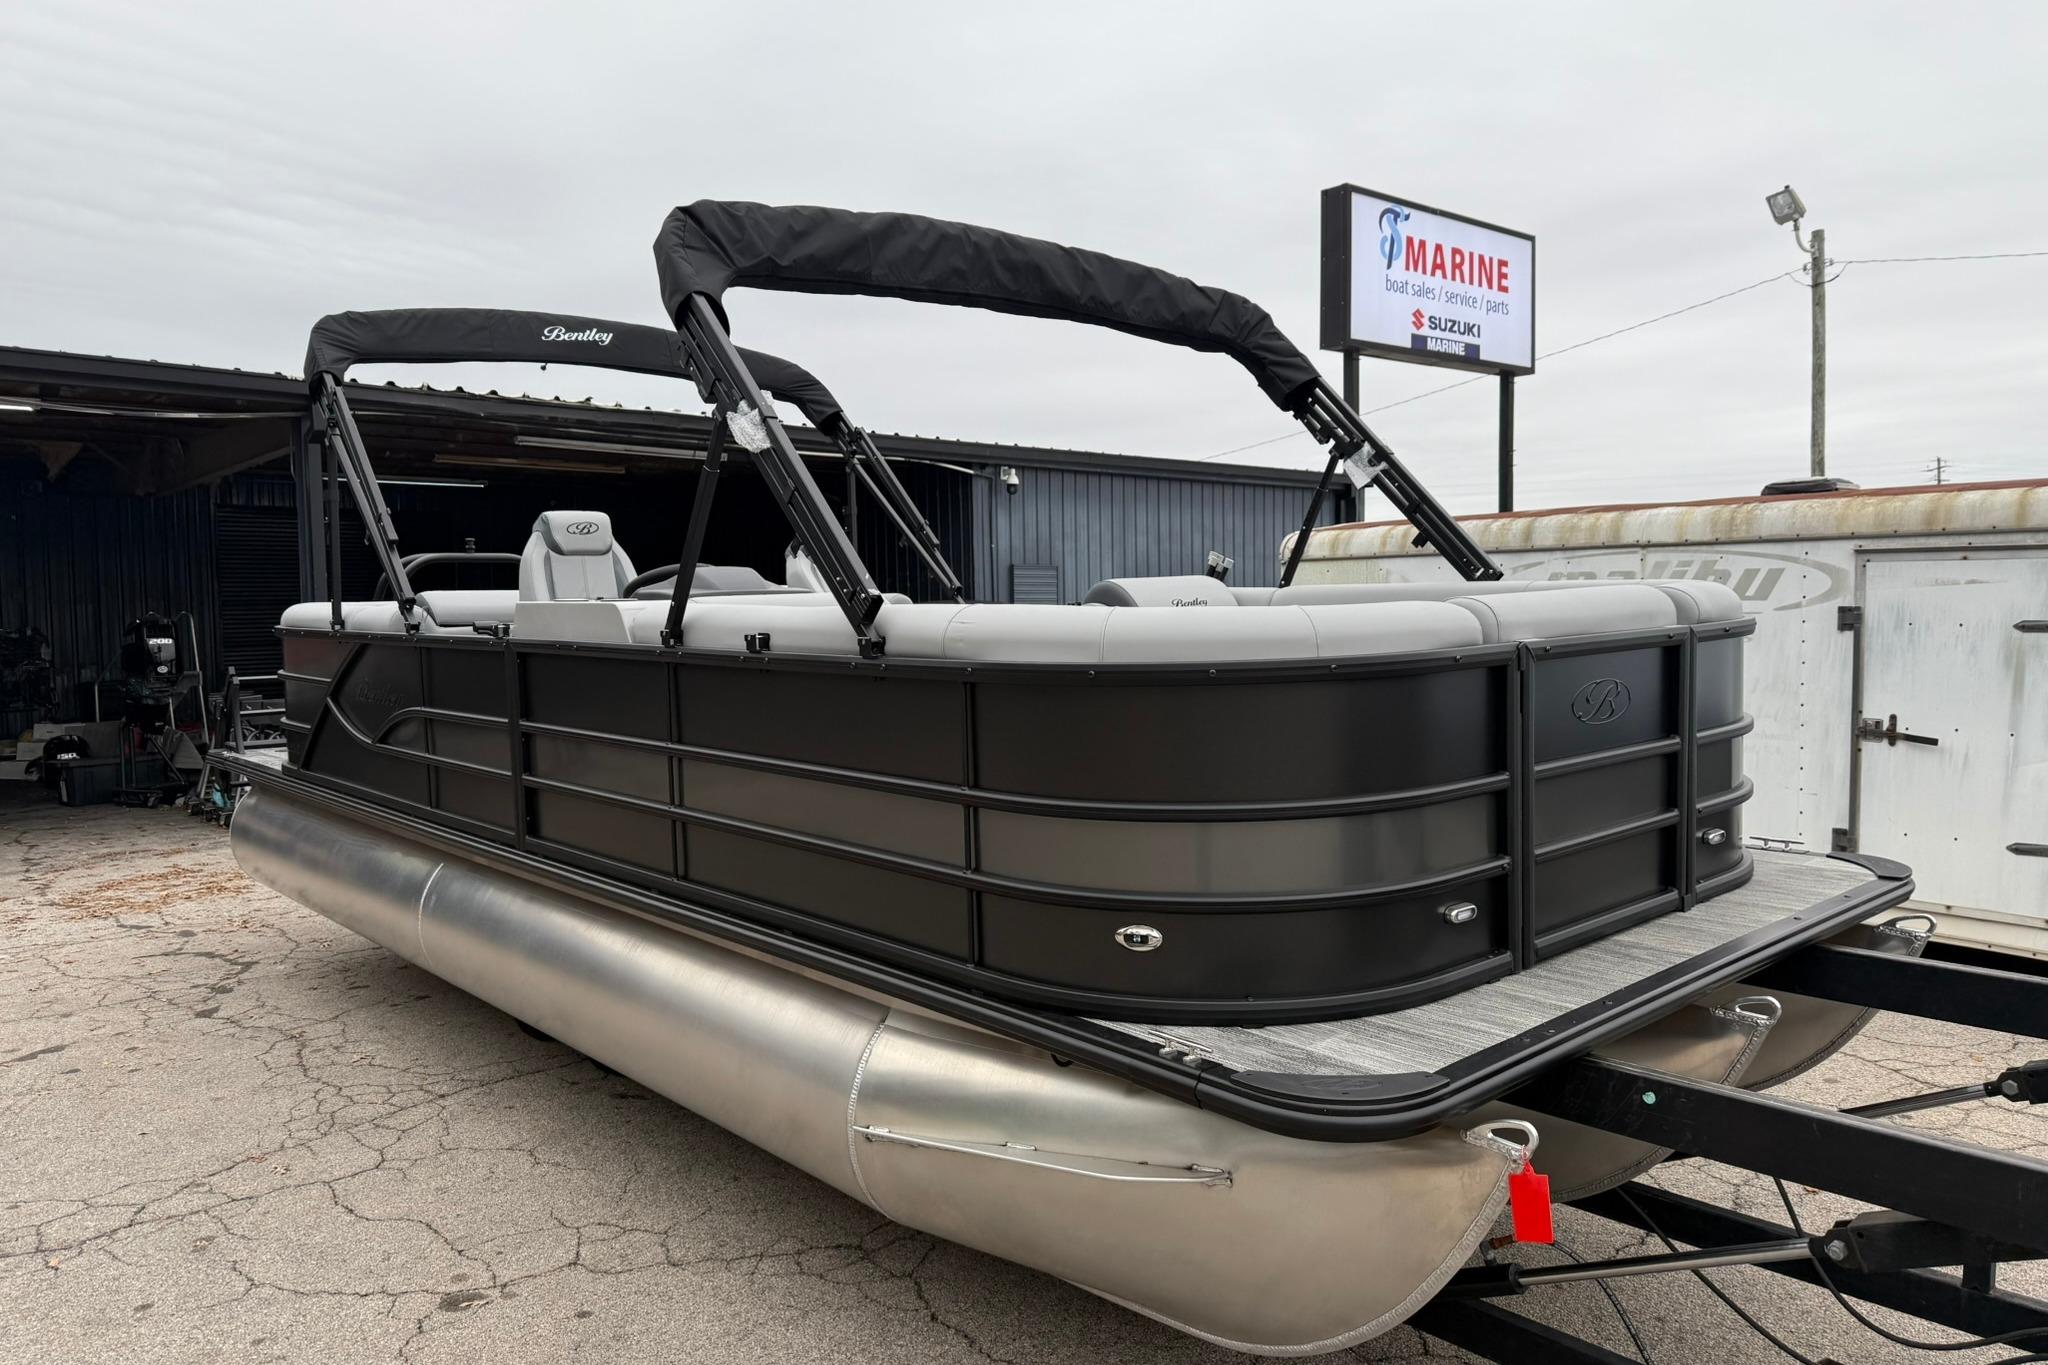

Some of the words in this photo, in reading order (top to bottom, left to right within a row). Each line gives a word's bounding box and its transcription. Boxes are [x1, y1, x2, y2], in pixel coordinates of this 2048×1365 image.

[1405, 235, 1509, 293] MARINE
[1385, 274, 1409, 295] boat
[1411, 281, 1436, 301] sales
[1445, 290, 1478, 310] service
[1486, 299, 1510, 316] parts
[541, 325, 613, 346] Bentley
[1428, 315, 1481, 338] SUZUKI
[1426, 337, 1466, 356] MARINE
[148, 637, 173, 645] 200
